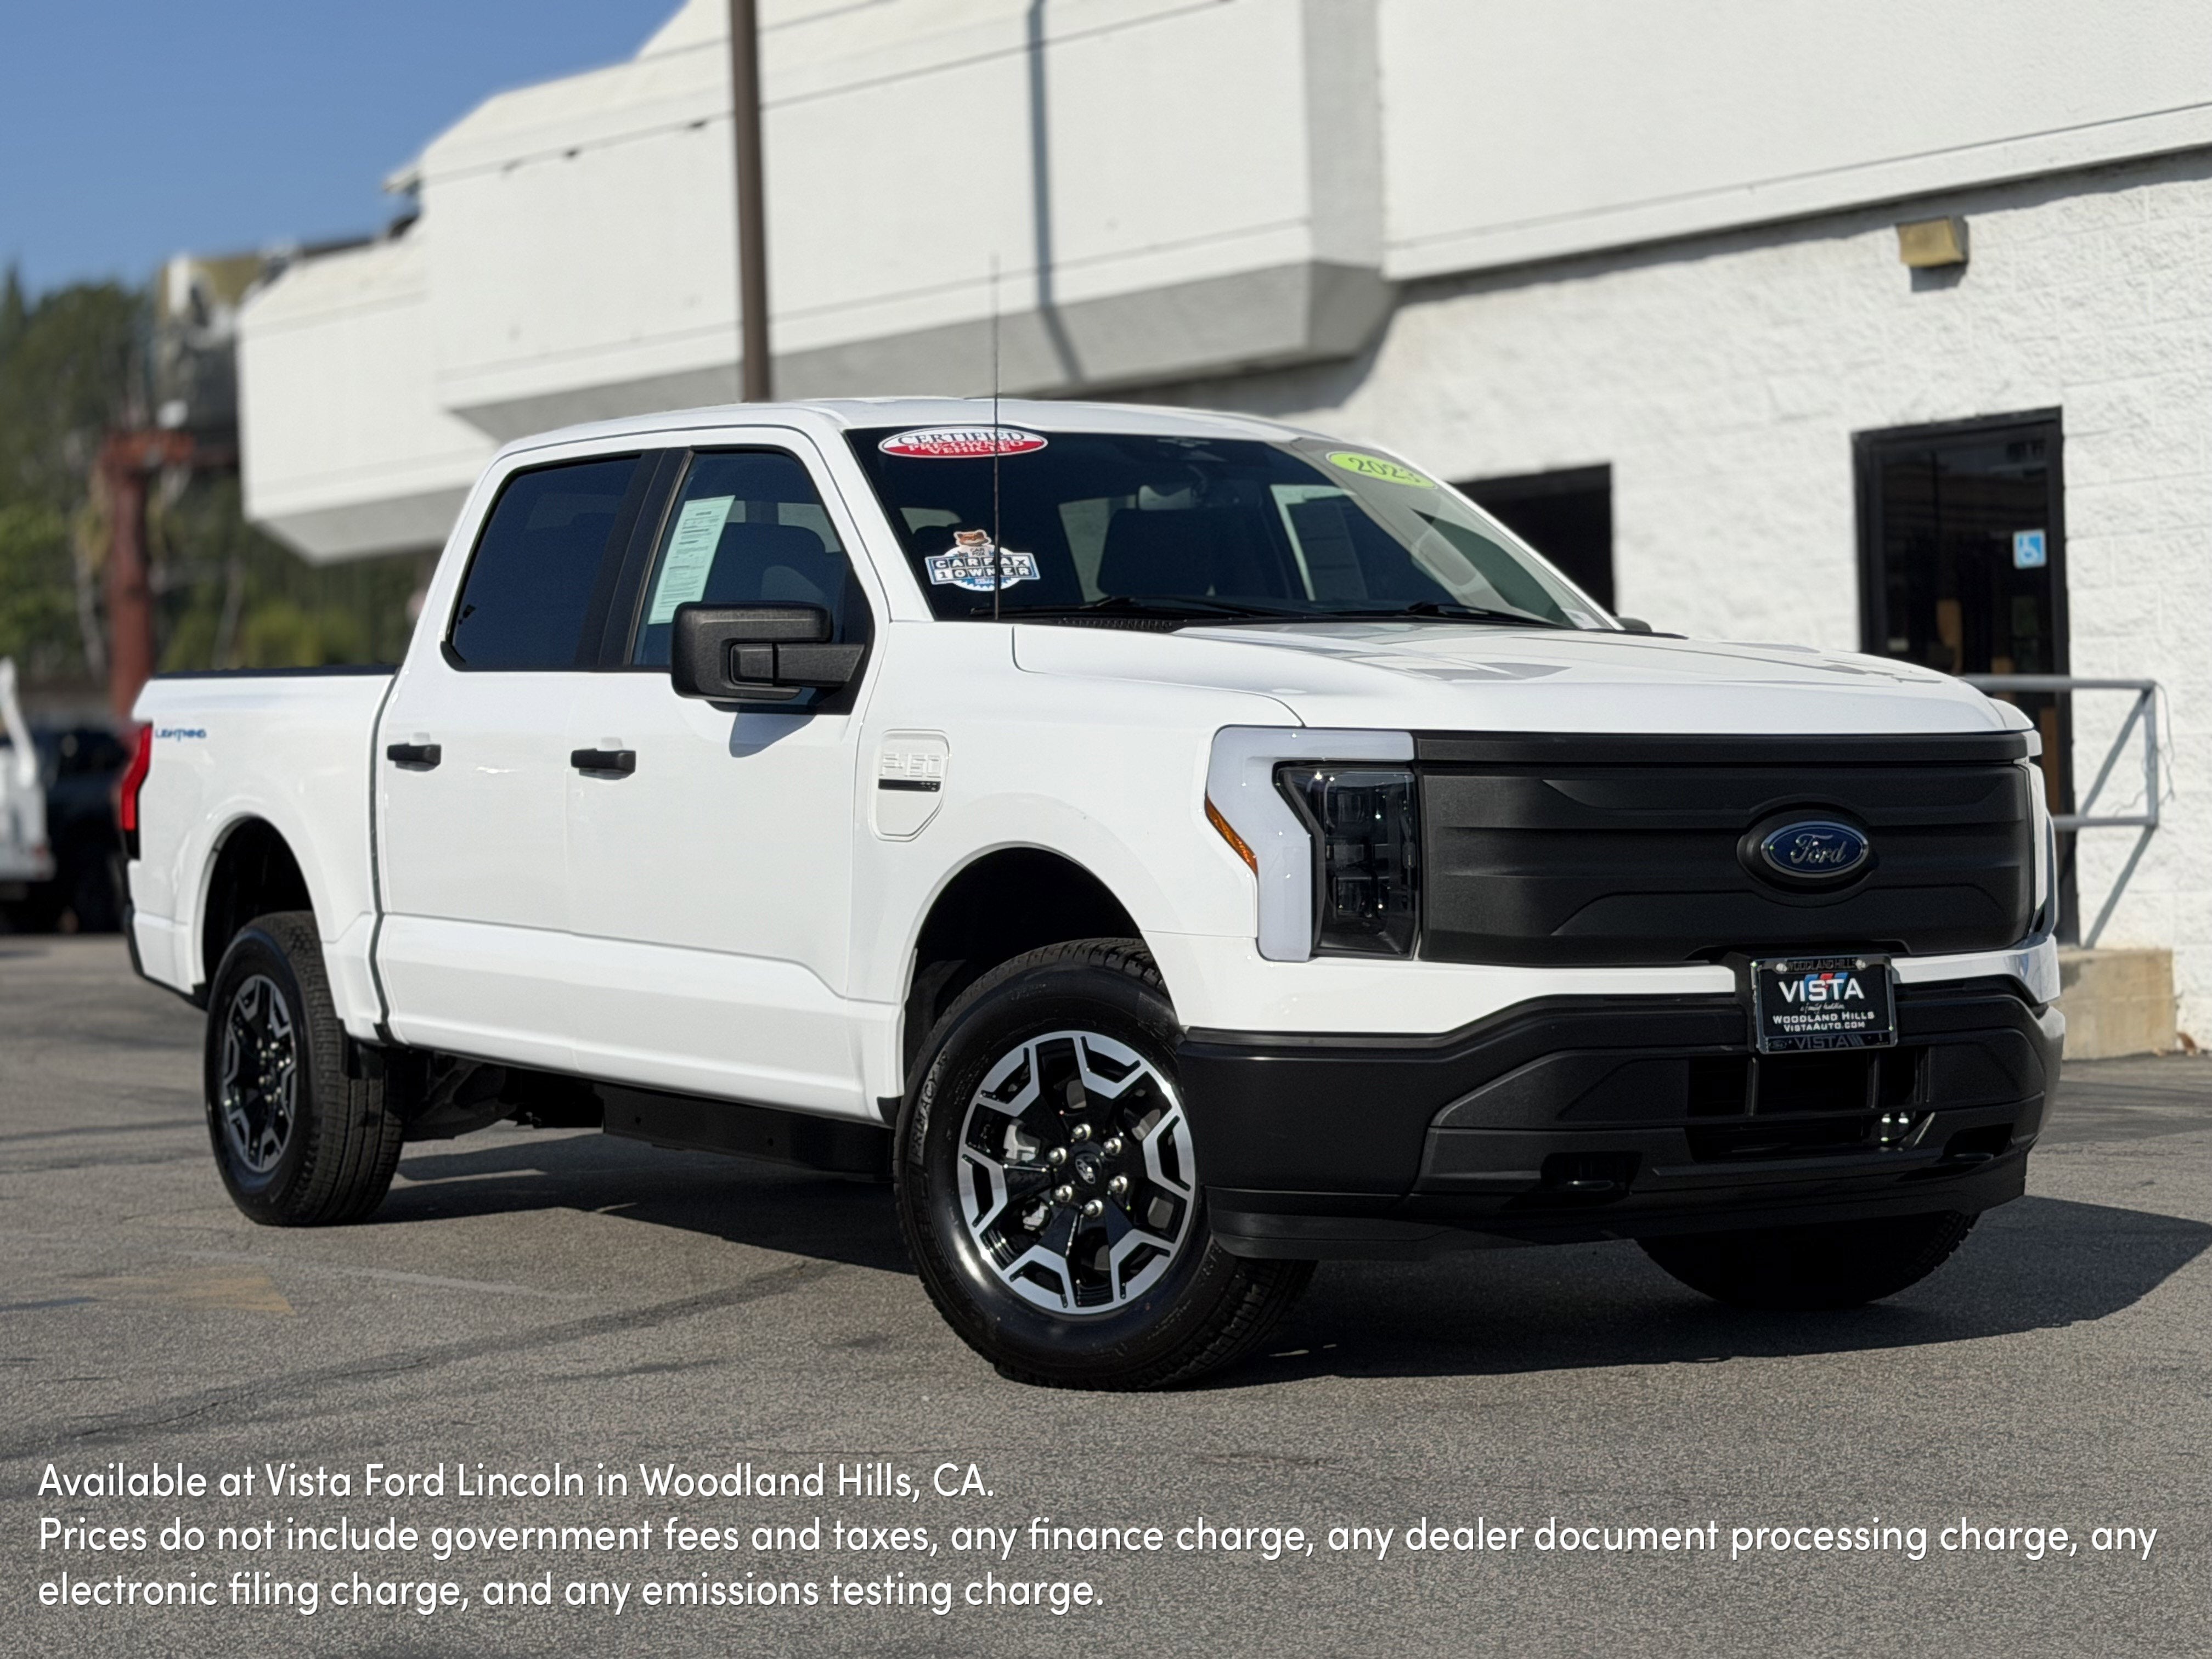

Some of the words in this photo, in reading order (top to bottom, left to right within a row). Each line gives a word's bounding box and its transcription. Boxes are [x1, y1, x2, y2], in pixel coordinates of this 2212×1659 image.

[898, 432, 1025, 445] CERTIFIED
[928, 444, 1012, 454] VEHICLE
[935, 557, 1025, 568] CARFAX
[954, 567, 1030, 577] OWNER
[1790, 833, 1847, 864] Ford
[1778, 977, 1865, 1003] VISTA
[1773, 1013, 1838, 1025] WOODLAND
[1841, 1011, 1875, 1021] HILLS
[1793, 1034, 1853, 1050] VISTA
